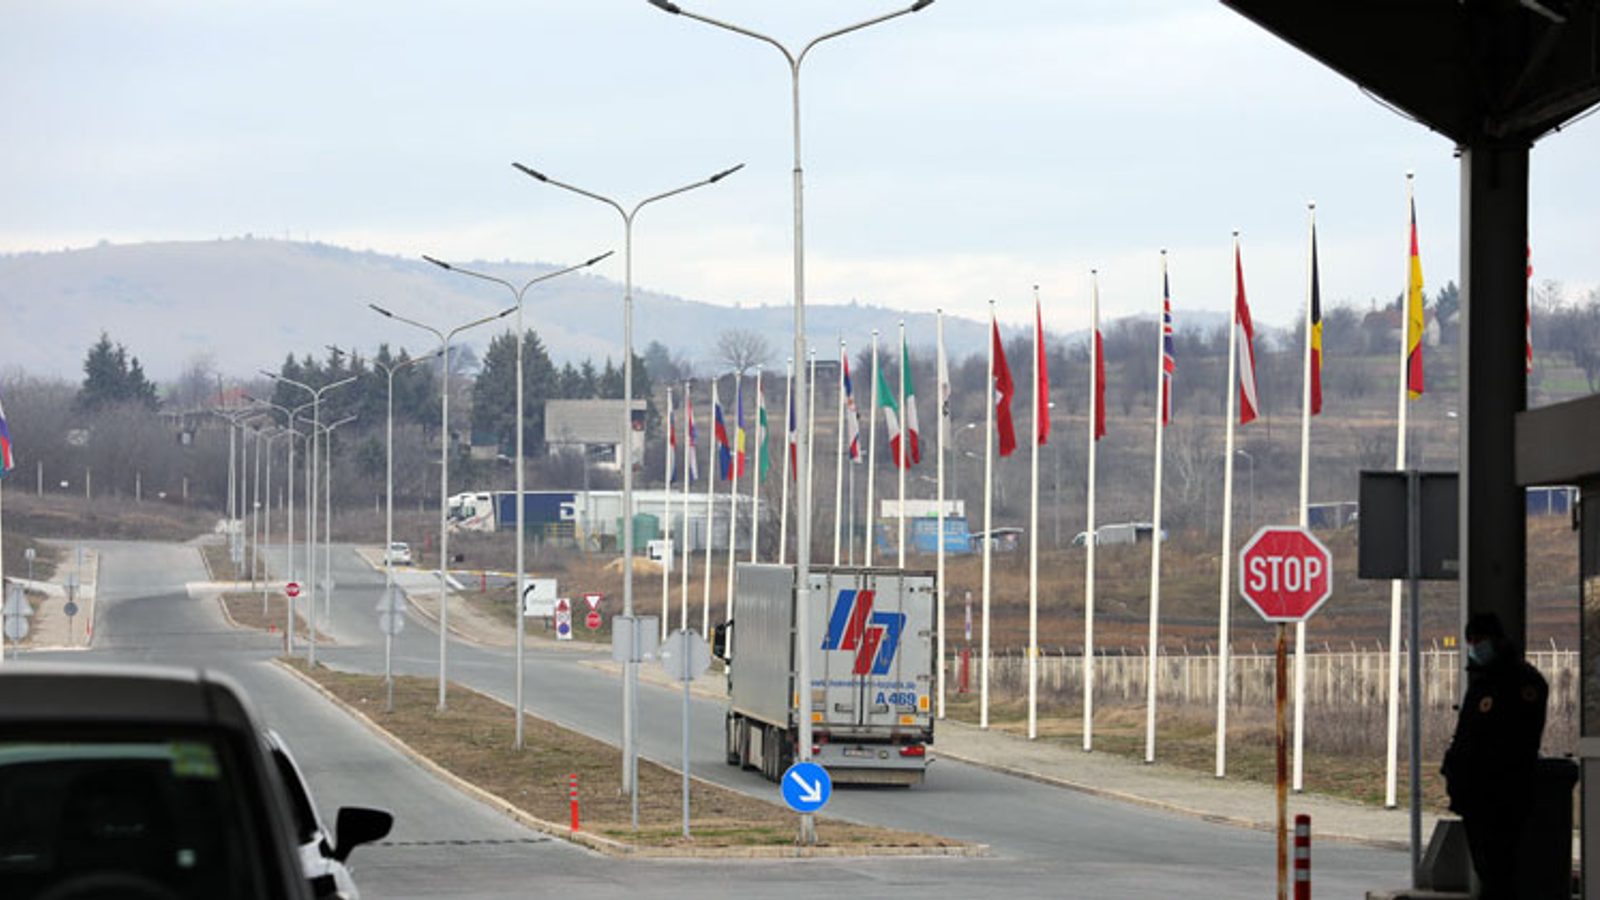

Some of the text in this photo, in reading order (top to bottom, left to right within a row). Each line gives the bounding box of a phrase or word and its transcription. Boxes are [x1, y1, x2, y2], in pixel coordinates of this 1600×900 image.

[1250, 556, 1321, 592] STOP
[876, 692, 917, 705] A 469
